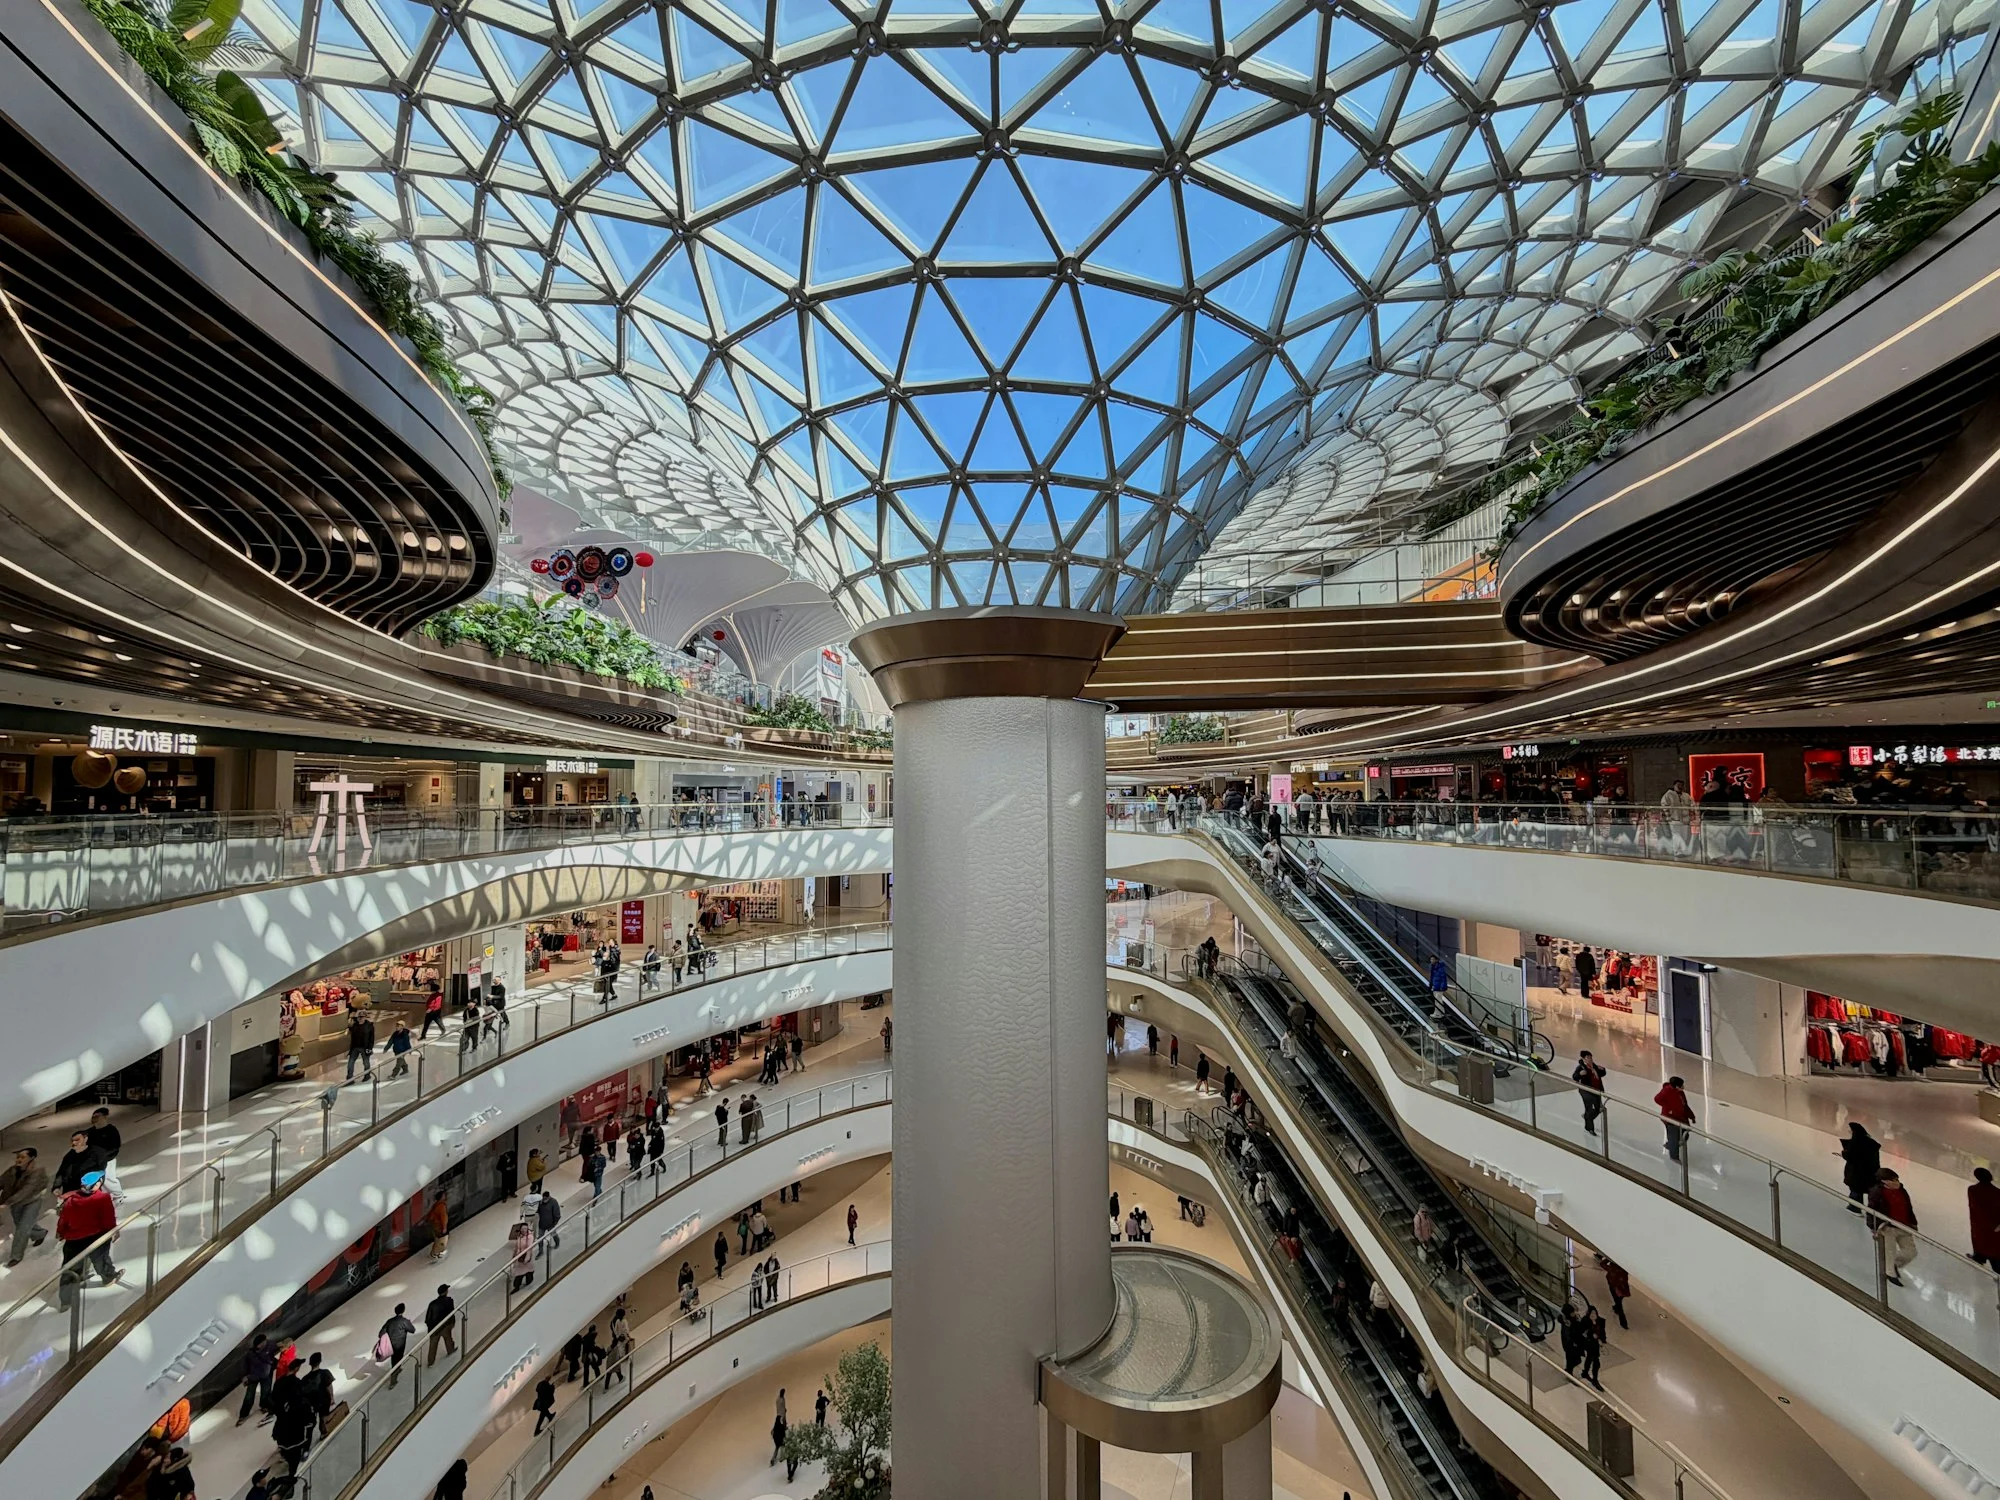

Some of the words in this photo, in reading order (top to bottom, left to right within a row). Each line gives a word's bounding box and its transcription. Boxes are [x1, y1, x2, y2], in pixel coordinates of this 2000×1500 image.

[90, 724, 173, 753] 源氏木语
[1475, 965, 1488, 977] L4
[1500, 971, 1514, 984] L4
